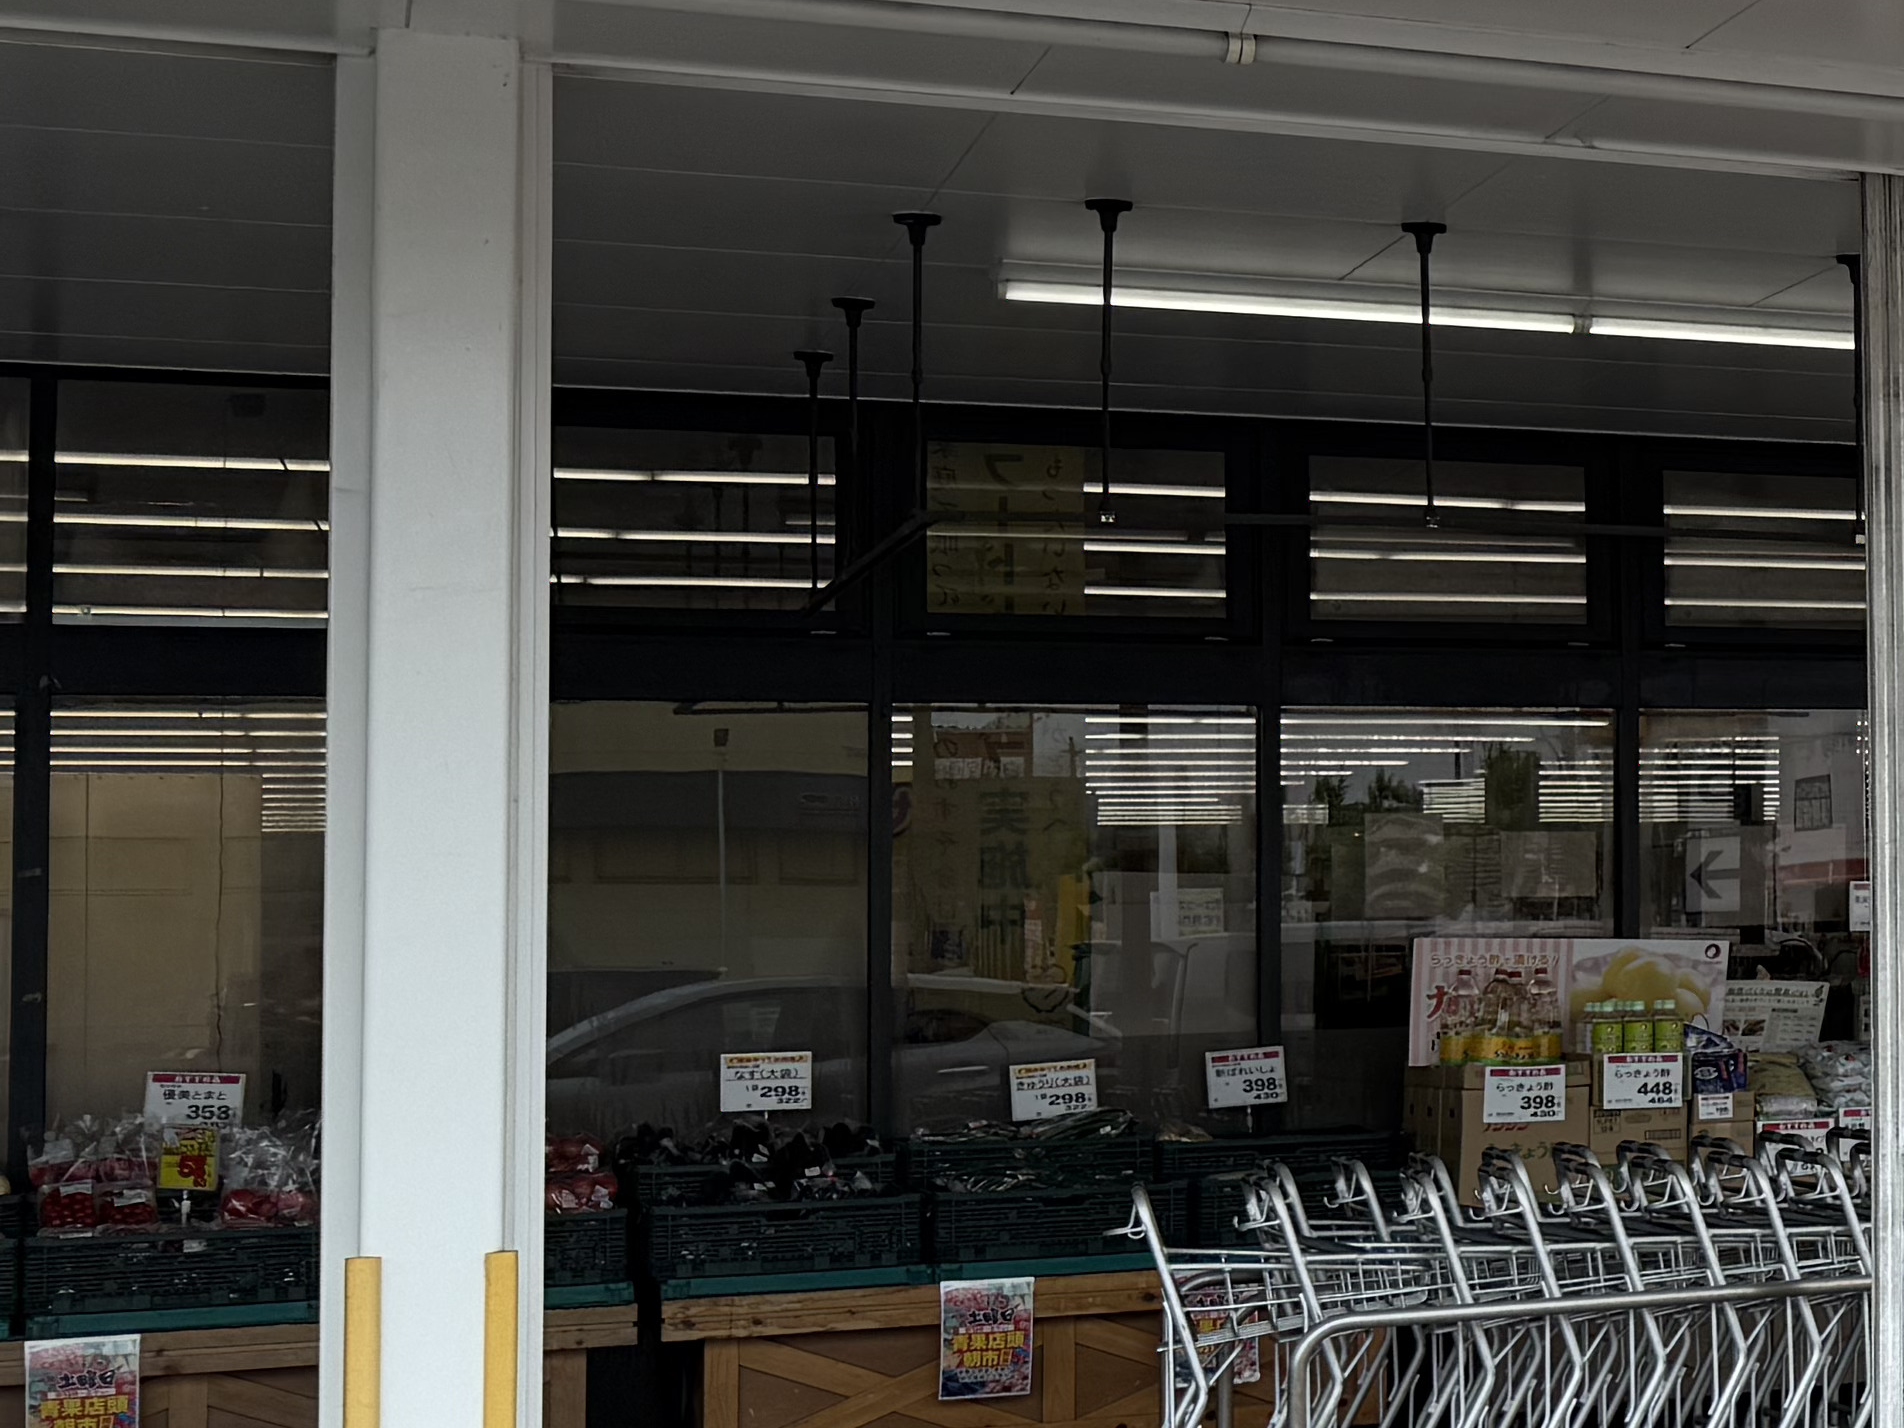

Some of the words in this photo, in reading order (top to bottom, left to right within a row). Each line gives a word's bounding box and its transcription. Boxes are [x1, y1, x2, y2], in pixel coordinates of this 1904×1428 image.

[760, 1085, 800, 1098] 298
[1242, 1077, 1277, 1093] 398
[1637, 1081, 1673, 1096] 448
[1049, 1092, 1086, 1106] 298
[1520, 1095, 1556, 1110] 398
[40, 1395, 129, 1419] 青果店頭
